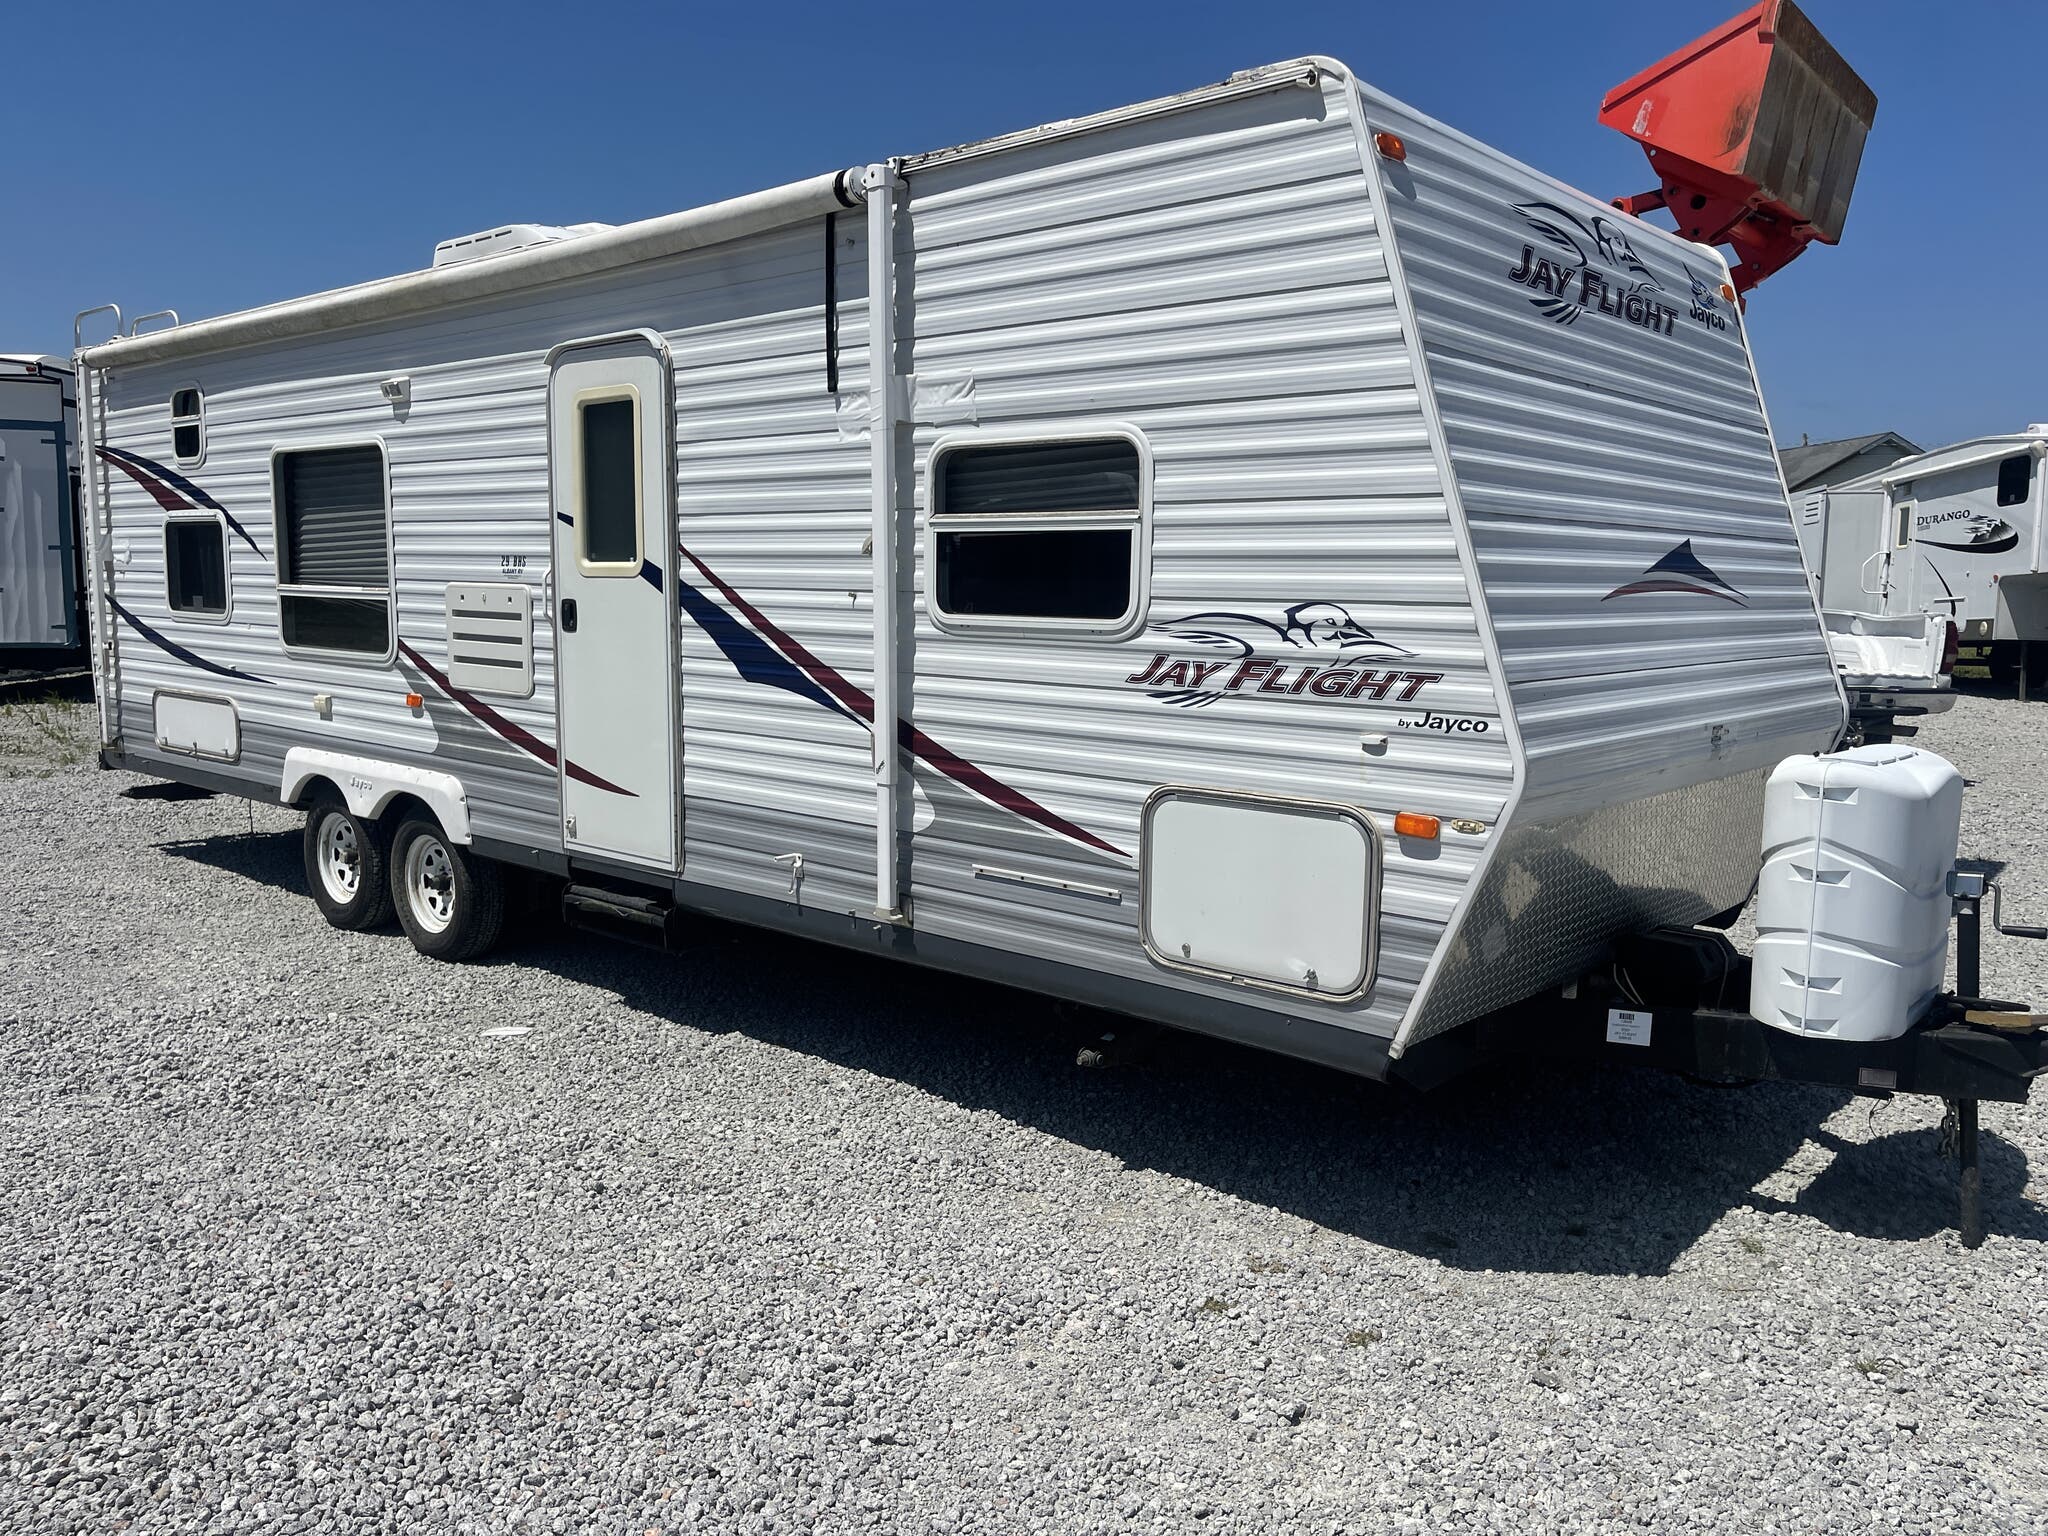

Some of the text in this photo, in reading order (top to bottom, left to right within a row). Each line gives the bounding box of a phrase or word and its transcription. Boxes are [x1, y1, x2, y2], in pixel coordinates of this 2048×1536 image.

[1508, 244, 1679, 337] JAY FLIGHT
[1689, 298, 1726, 332] Jayco
[1917, 509, 1971, 526] DURANGO
[1125, 653, 1445, 702] JAY FLIGHT
[1397, 711, 1489, 734] by Jayco
[350, 776, 373, 791] Jayco
